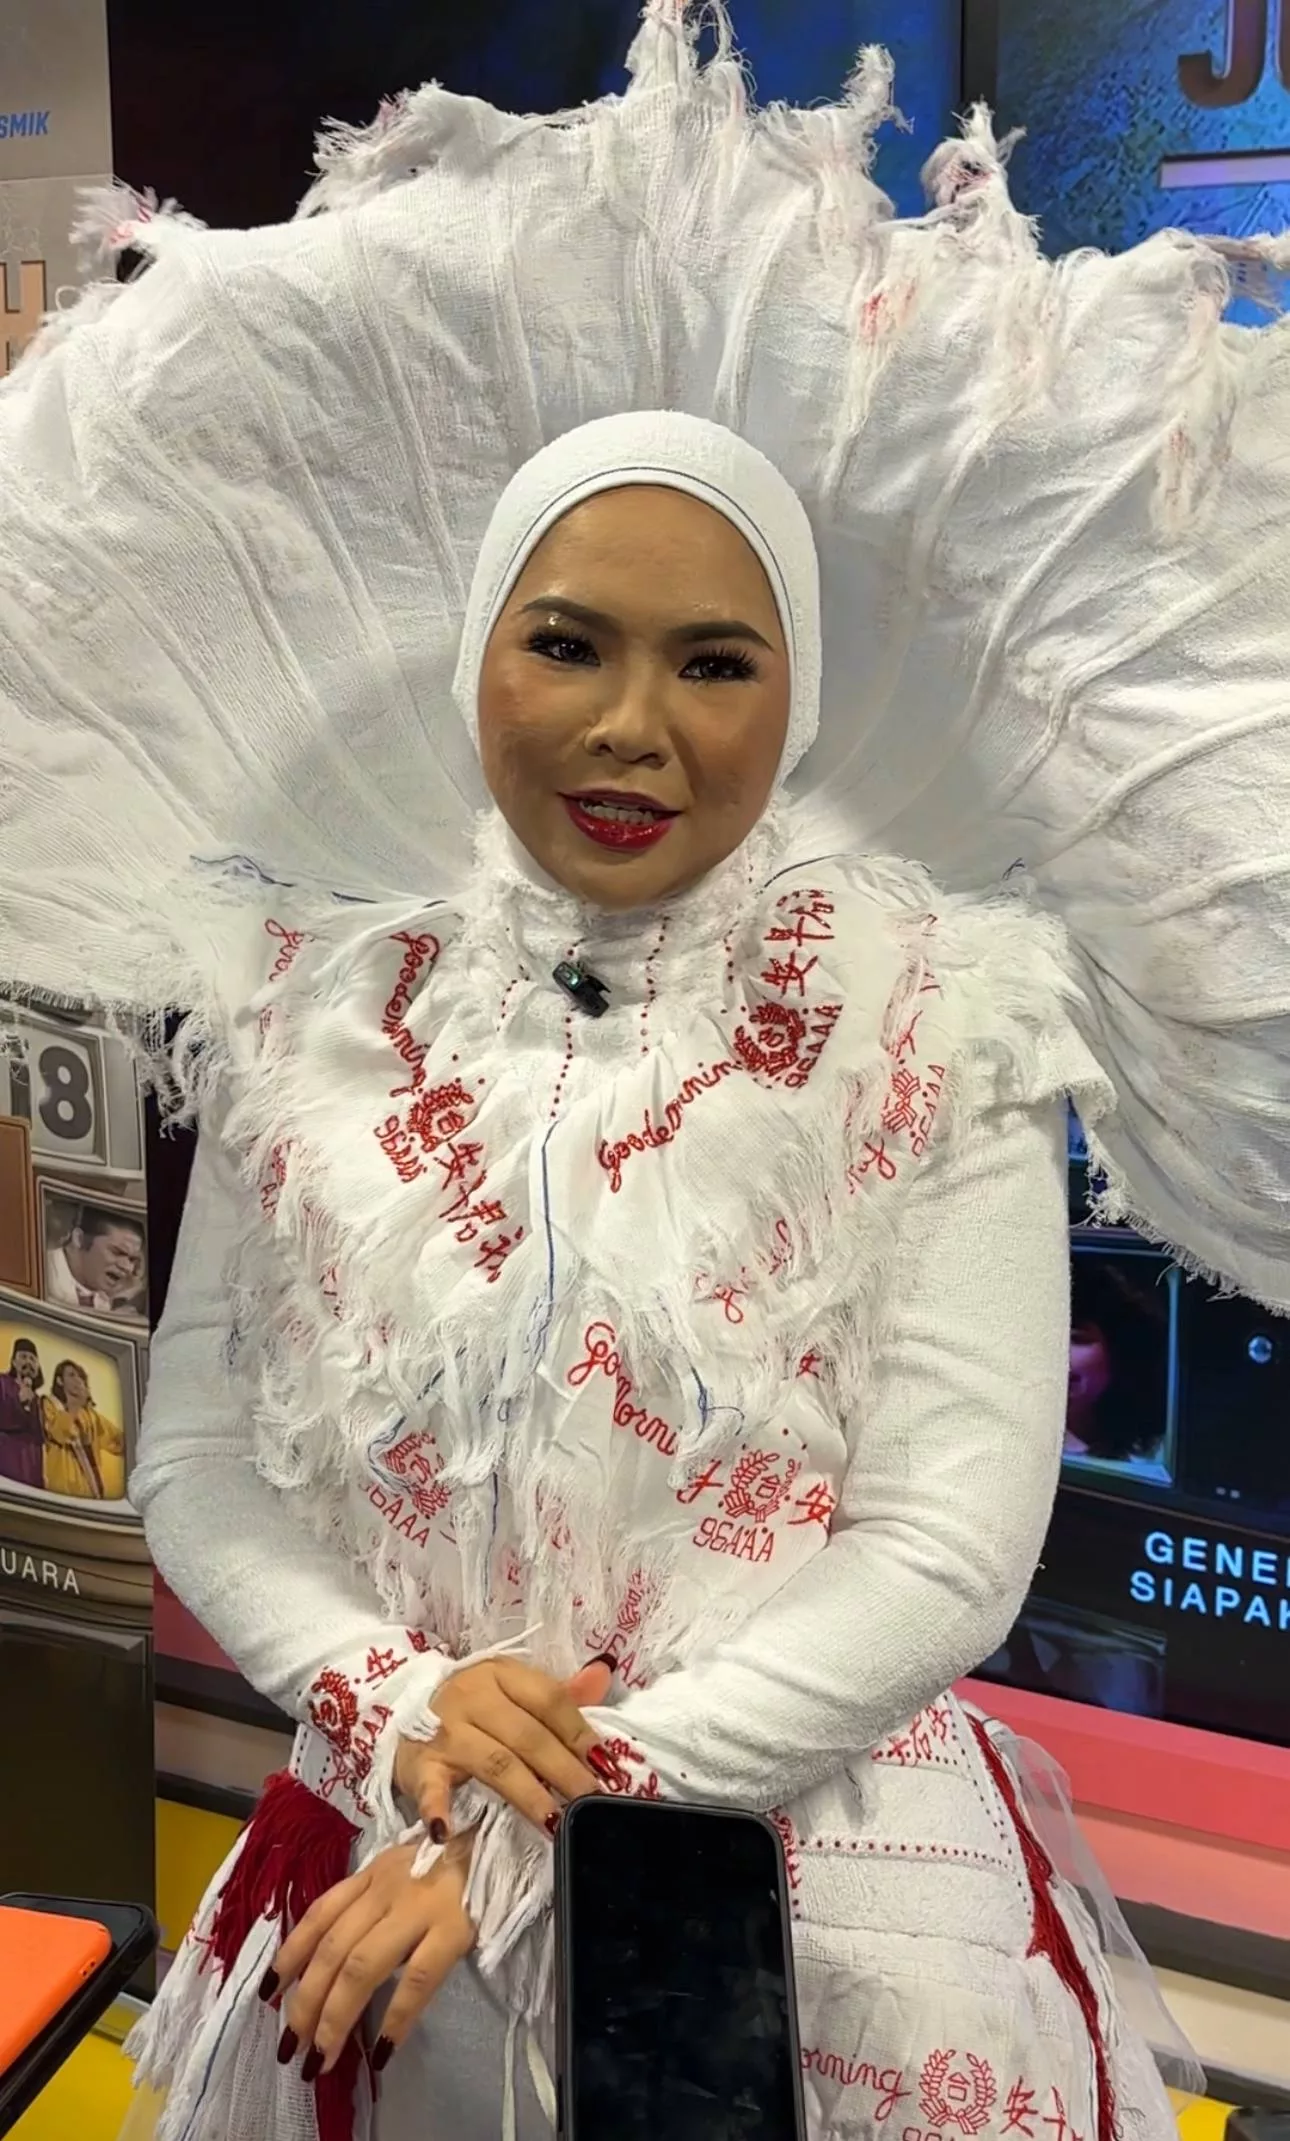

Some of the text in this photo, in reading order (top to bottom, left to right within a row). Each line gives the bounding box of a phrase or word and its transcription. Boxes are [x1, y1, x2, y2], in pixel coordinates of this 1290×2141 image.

[691, 1515, 776, 1563] 96AAA
[1144, 1531, 1290, 1588] GENE
[799, 2045, 913, 2122] orning
